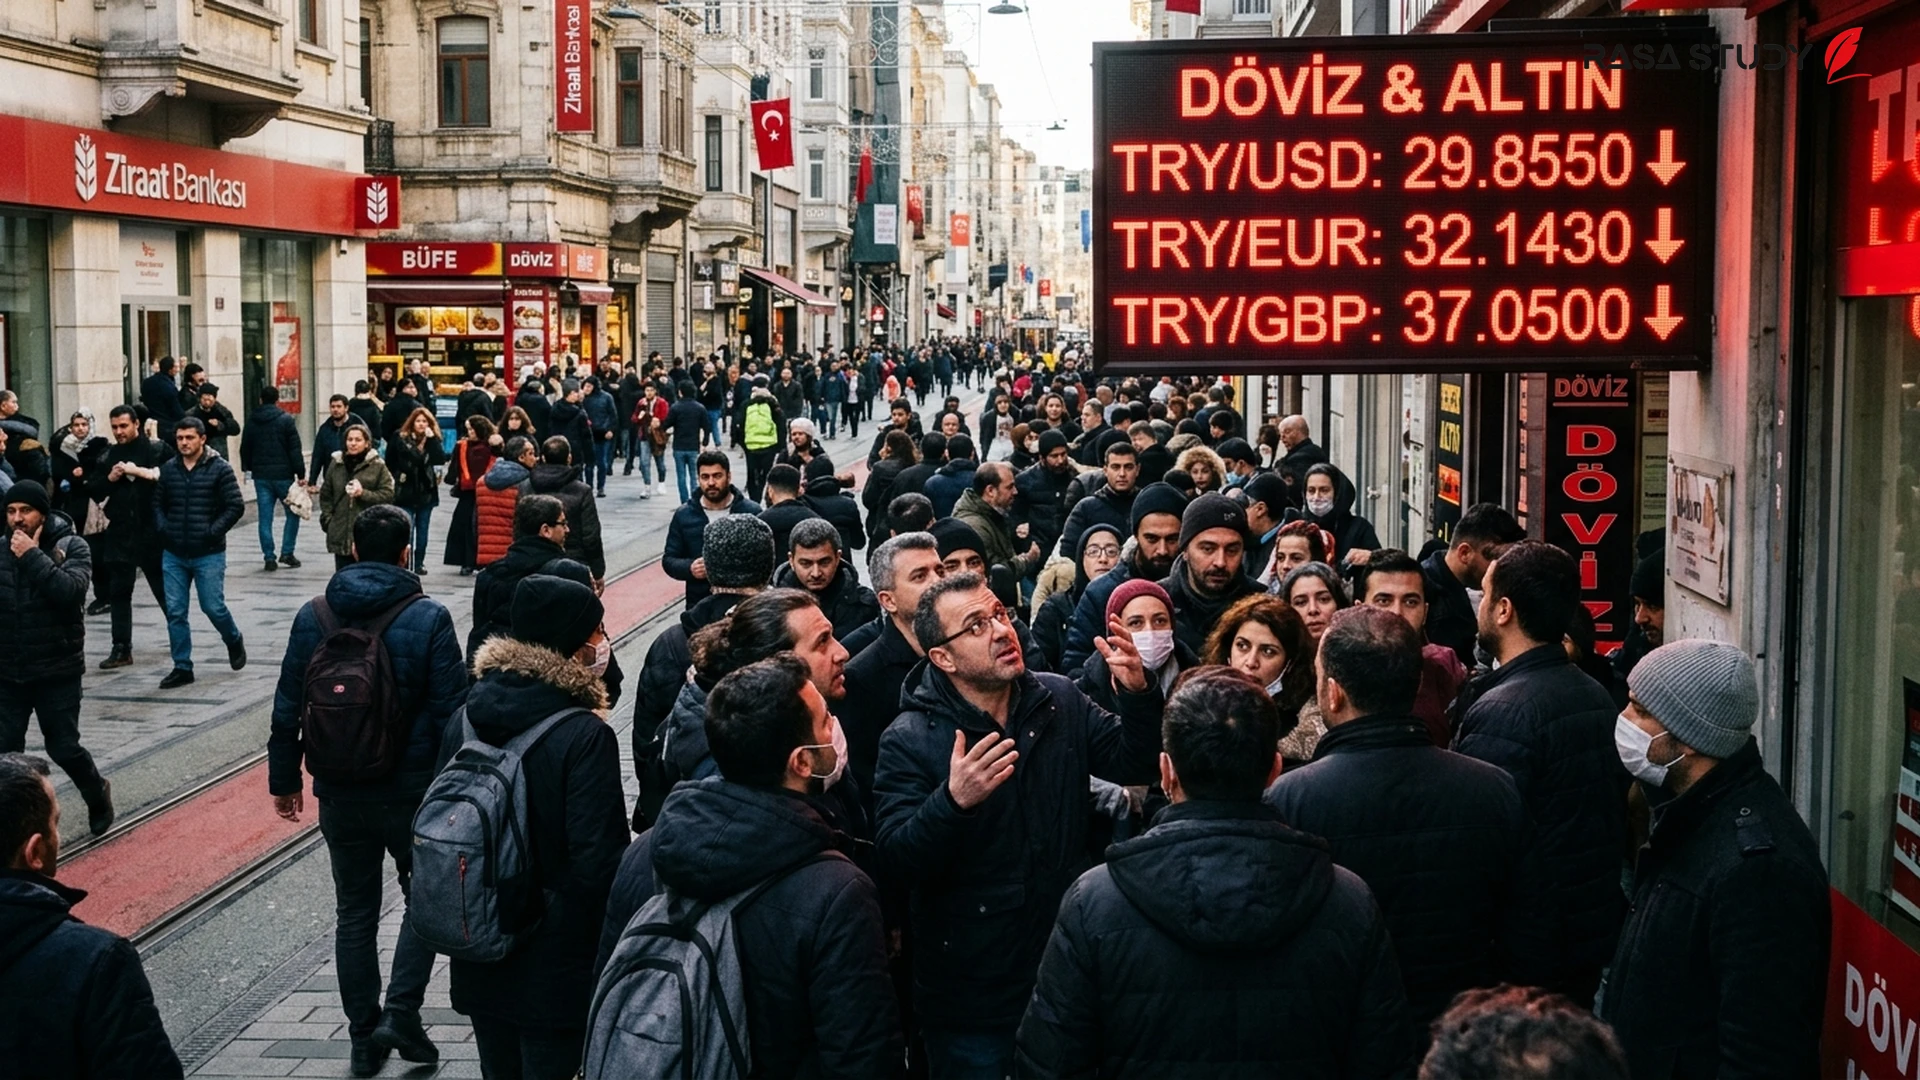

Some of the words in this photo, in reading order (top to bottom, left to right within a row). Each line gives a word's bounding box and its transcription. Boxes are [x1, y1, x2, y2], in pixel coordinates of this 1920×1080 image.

[1180, 53, 1365, 118] DÖVİZ
[1382, 64, 1424, 113] &
[1442, 60, 1623, 112] ALTIN
[104, 152, 170, 199] Ziraat
[173, 162, 247, 209] Bankası
[1111, 140, 1383, 192] TRY/USD:
[1403, 133, 1633, 190] 29.8550
[402, 246, 458, 269] BÜFE
[510, 250, 554, 267] DÖVİZ
[1111, 217, 1383, 269] TRY/EUR:
[1403, 210, 1633, 267] 32.1430
[1111, 294, 1383, 346] TRY/GBP:
[1403, 287, 1632, 344] 37.0500
[1554, 373, 1629, 399] DÖVİZ
